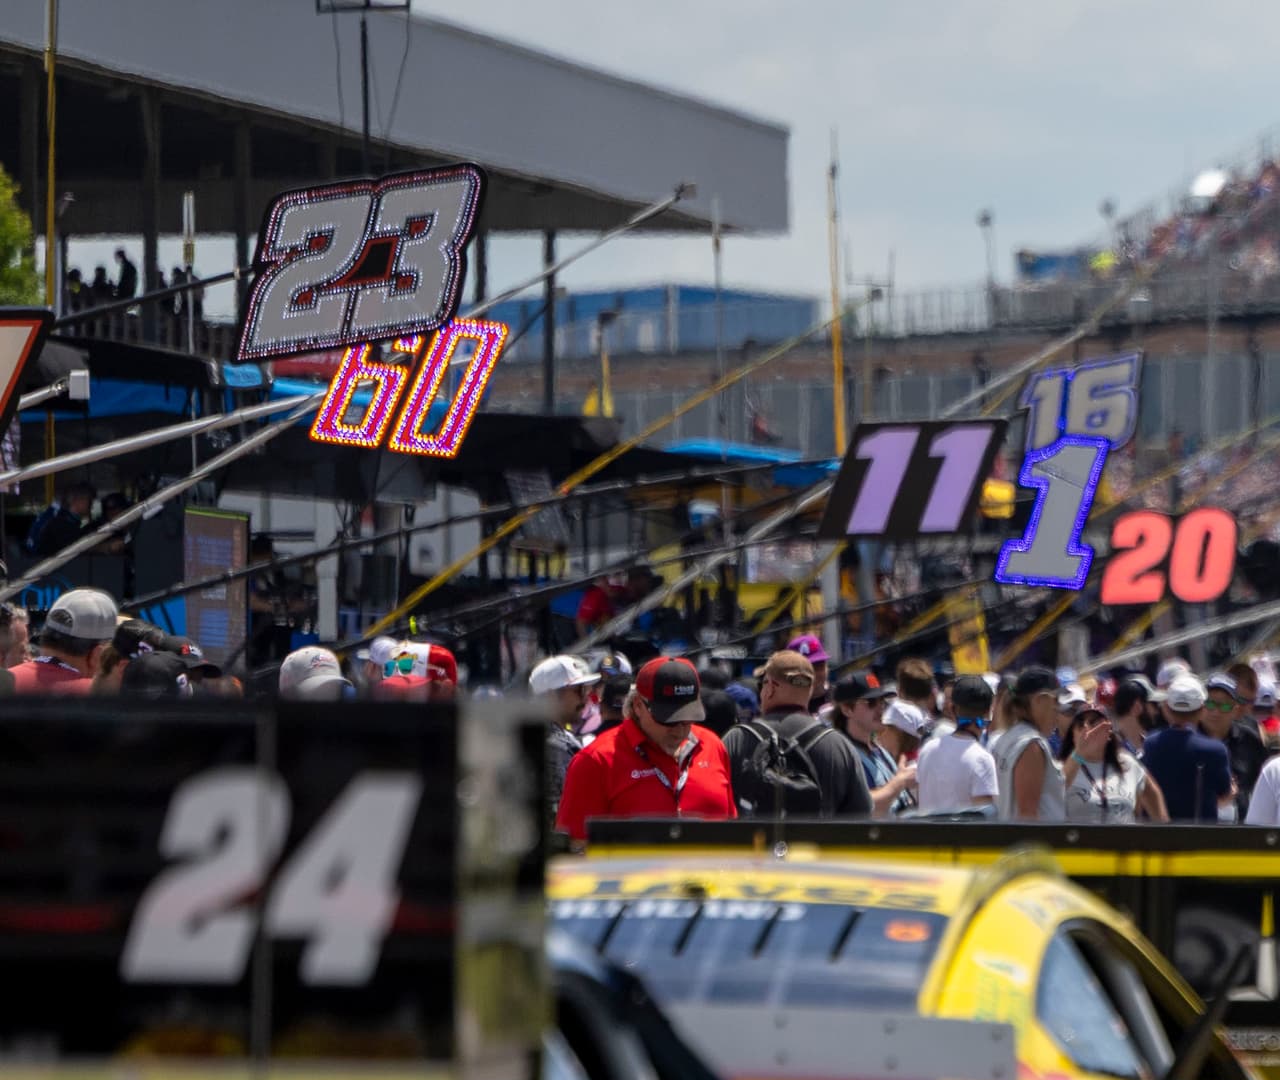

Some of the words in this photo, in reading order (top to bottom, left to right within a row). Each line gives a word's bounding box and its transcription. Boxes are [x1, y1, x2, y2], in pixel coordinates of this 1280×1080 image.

[244, 168, 482, 352] 23
[311, 318, 508, 458] 60
[1024, 355, 1138, 447] 16
[846, 425, 994, 535] 11
[996, 435, 1110, 590] 1
[1102, 508, 1237, 605] 20
[118, 765, 424, 988] 24
